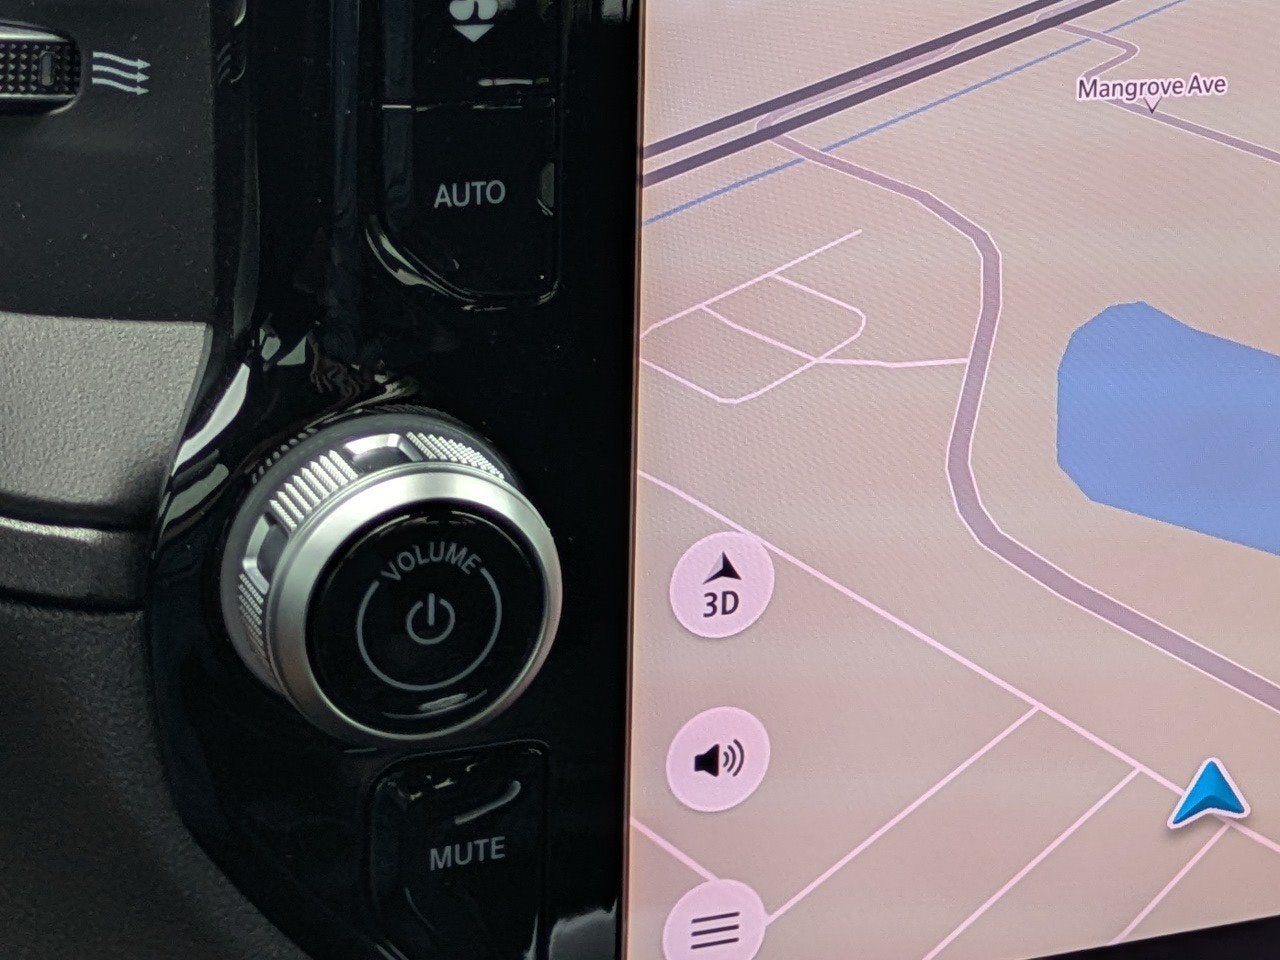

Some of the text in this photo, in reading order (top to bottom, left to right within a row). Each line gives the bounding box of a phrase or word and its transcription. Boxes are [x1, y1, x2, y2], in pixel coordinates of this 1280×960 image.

[1077, 76, 1227, 101] Mangrove Ave
[433, 179, 507, 209] AUTO
[381, 541, 484, 583] VOLUME
[702, 589, 740, 618] 3D
[429, 836, 507, 872] MUTE
